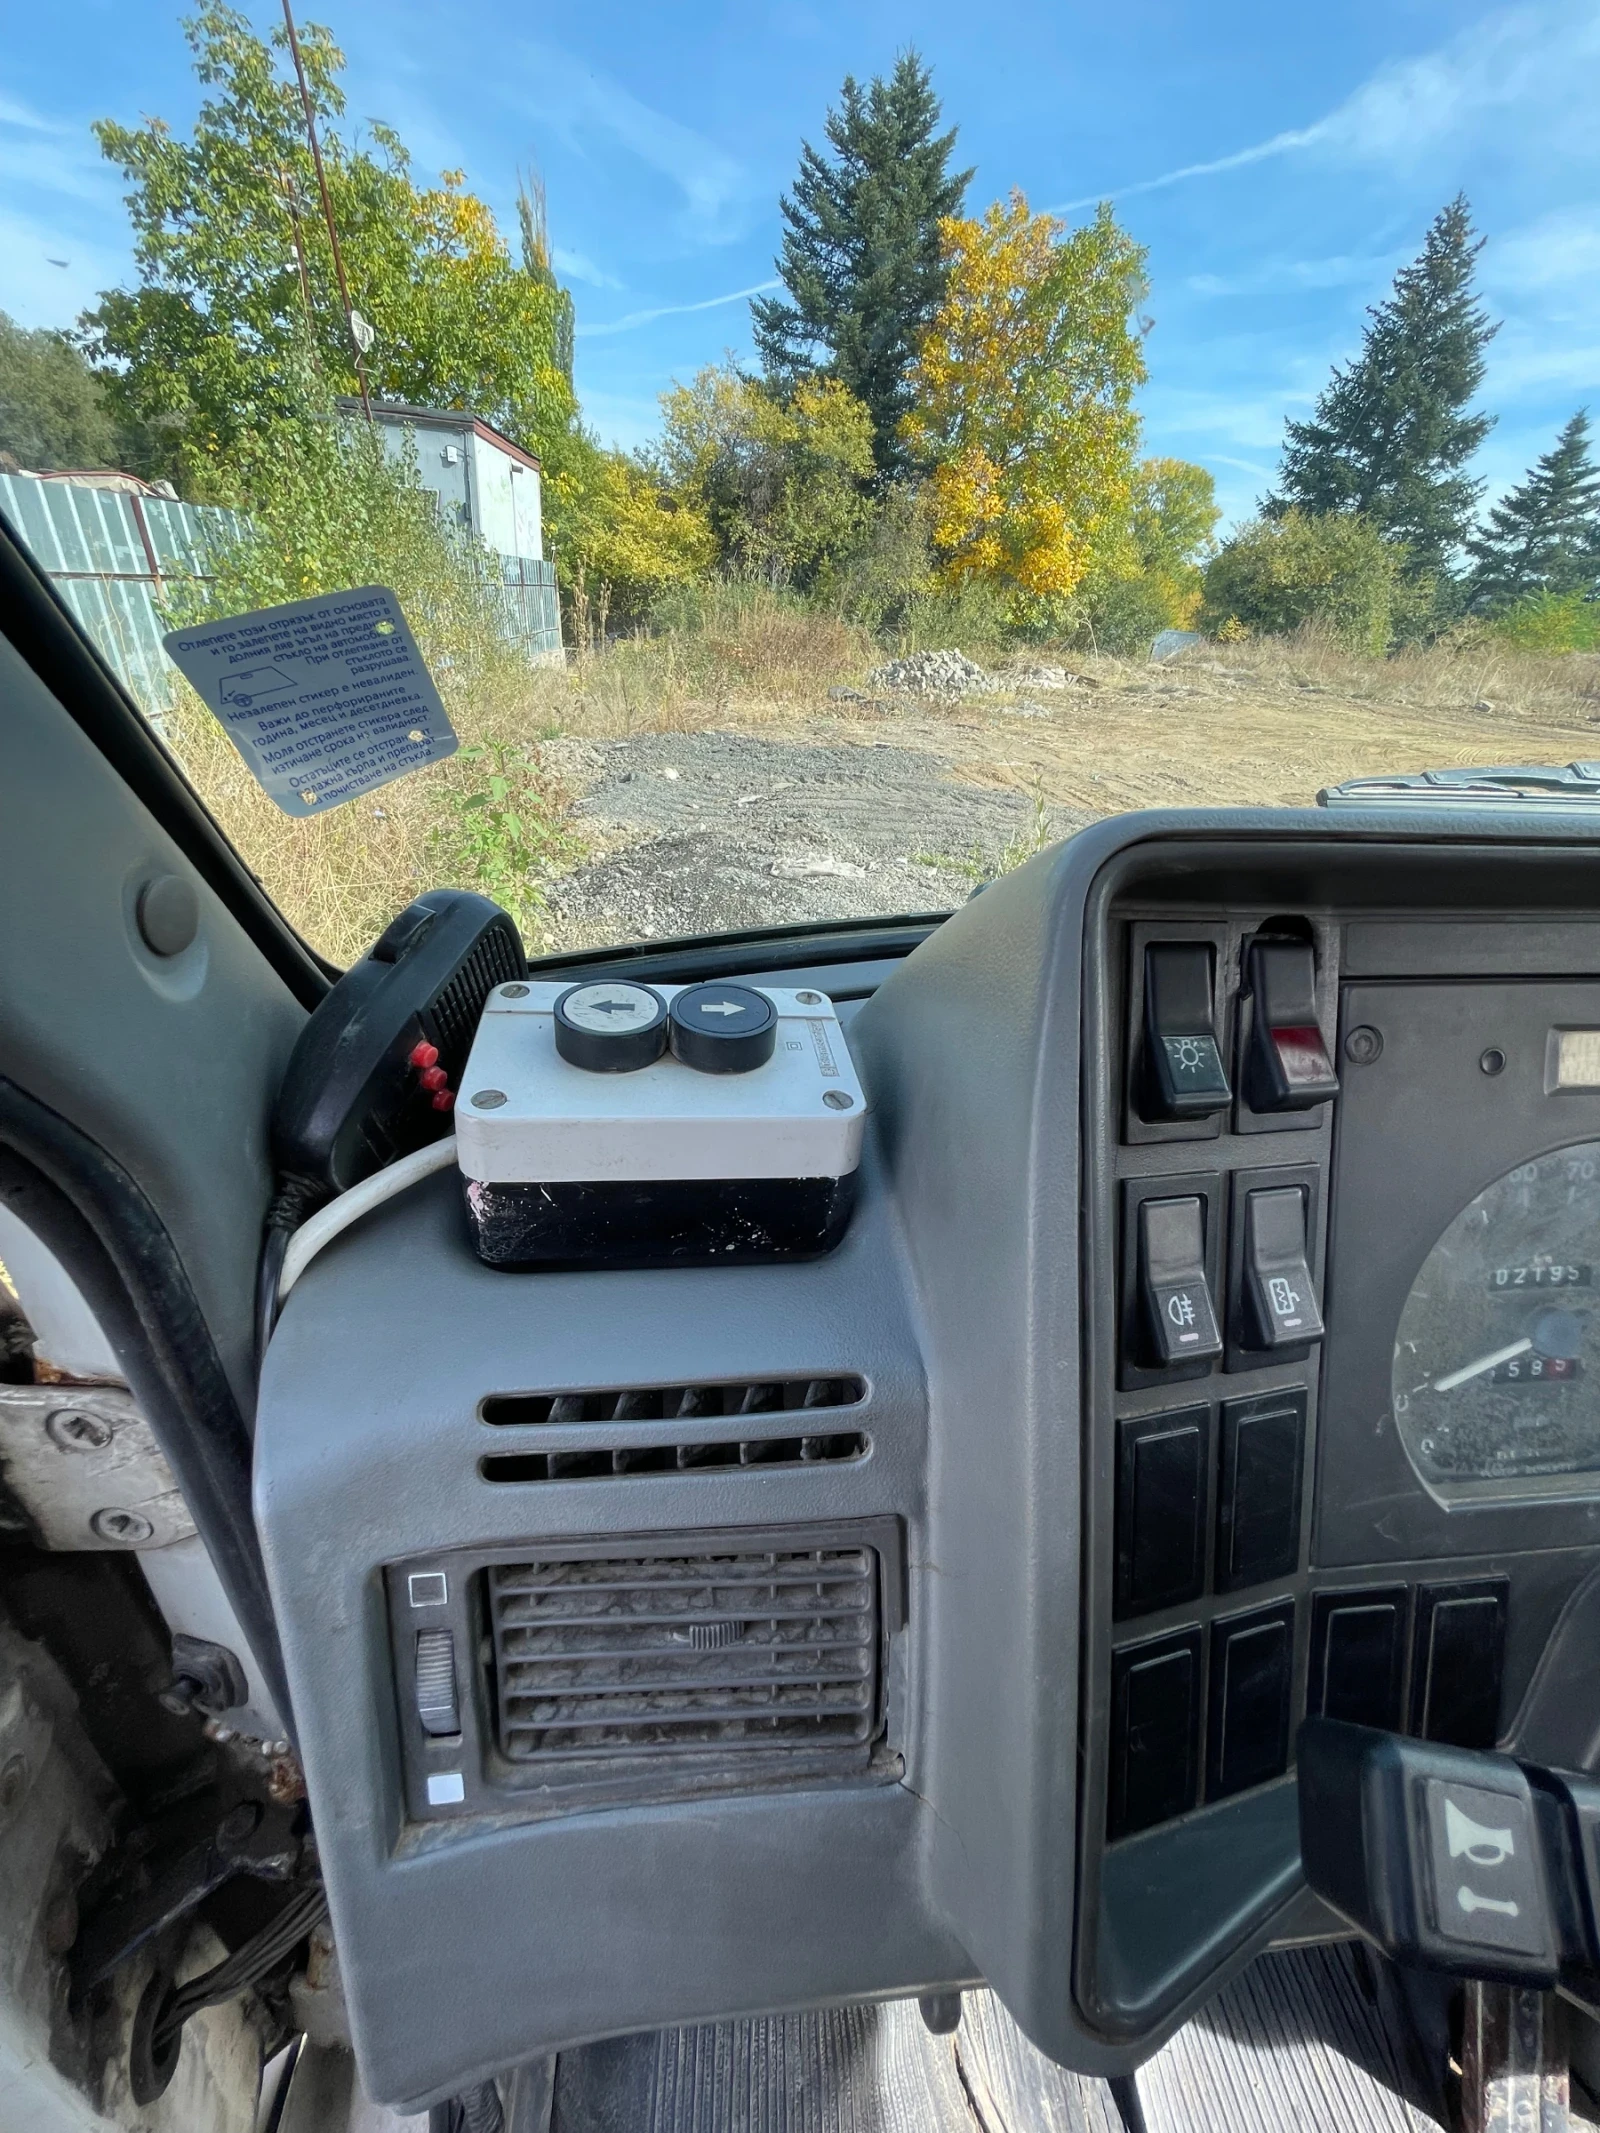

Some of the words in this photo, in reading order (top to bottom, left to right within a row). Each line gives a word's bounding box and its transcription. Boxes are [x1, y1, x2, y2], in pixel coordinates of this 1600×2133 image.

[178, 632, 236, 651] Отлепете
[237, 625, 266, 637] този
[268, 614, 316, 629] отрязък
[318, 610, 331, 618] от
[333, 597, 386, 614] основата
[210, 648, 220, 656] и
[221, 644, 236, 654] го
[237, 630, 291, 649] залепете
[293, 628, 308, 636] на
[310, 617, 346, 632] видно
[348, 609, 381, 623] място
[384, 607, 391, 615] в
[229, 647, 271, 664] долния
[274, 642, 294, 652] ляв
[295, 635, 322, 646] ъгъл
[324, 630, 339, 639] на
[273, 647, 311, 662] стъкло
[313, 643, 328, 652] на
[304, 653, 330, 665] При
[332, 640, 389, 658] отлепване
[391, 635, 404, 645] от
[345, 650, 393, 666] стъклото
[395, 645, 408, 654] се
[350, 655, 412, 676] разрушава.
[227, 699, 297, 722] Незалепен
[298, 687, 340, 703] стикер
[341, 684, 350, 692] е
[352, 668, 419, 690] невалиден.
[258, 716, 292, 731] Важи
[294, 711, 310, 722] до
[311, 686, 406, 716] перфорираните
[252, 727, 298, 748] година,
[299, 714, 338, 730] месец
[338, 711, 347, 719] и
[349, 692, 424, 717] десетдневка.
[262, 746, 295, 764] Моля
[295, 724, 356, 750] отстранете
[357, 711, 402, 729] стикера
[402, 705, 429, 716] след
[271, 748, 322, 775] изтичане
[323, 735, 356, 753] срока
[372, 714, 431, 735] валидност.
[344, 759, 377, 777] кърпа
[377, 755, 386, 763] и
[386, 736, 436, 759] препарат
[288, 756, 352, 788] Остатъците
[352, 750, 366, 760] се
[323, 769, 382, 800] почистване
[383, 763, 397, 773] на
[398, 748, 435, 766] стъкла.
[1567, 1160, 1595, 1180] 70
